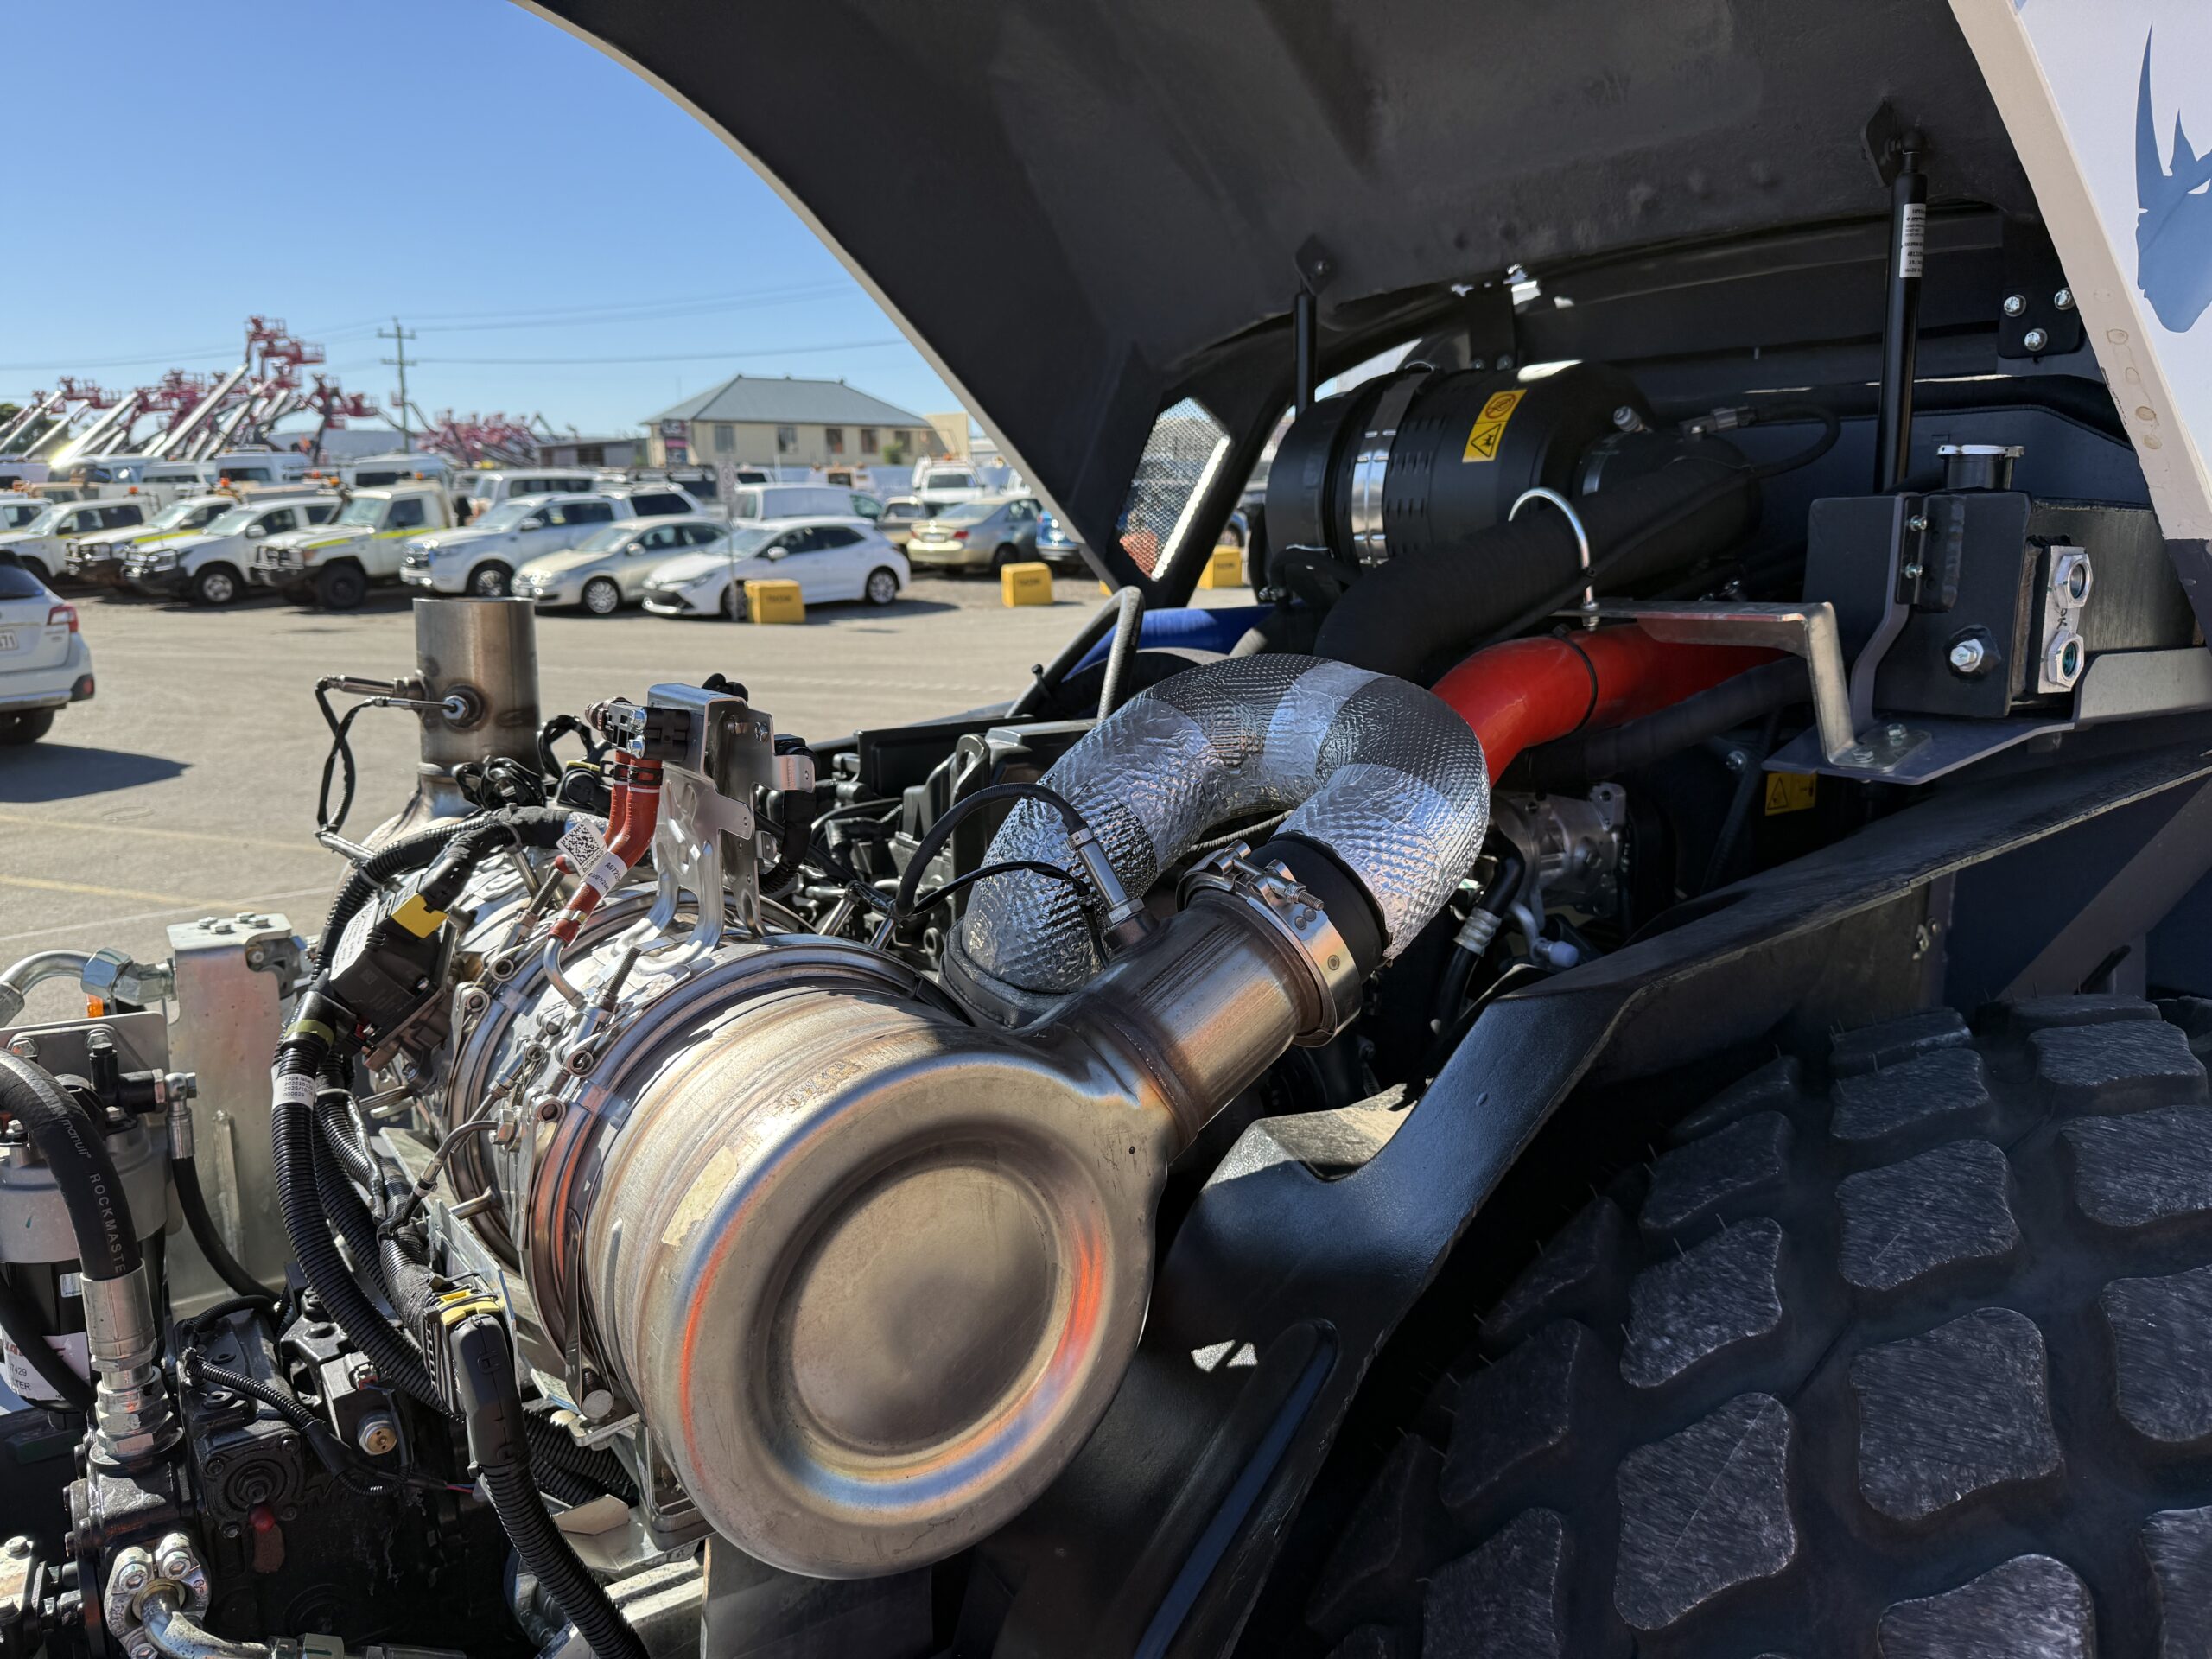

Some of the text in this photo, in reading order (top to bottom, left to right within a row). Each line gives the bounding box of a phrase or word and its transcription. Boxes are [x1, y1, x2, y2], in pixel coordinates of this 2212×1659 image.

[61, 1118, 89, 1156] manuli
[89, 1173, 126, 1274] ROCKMASTE
[14, 1378, 31, 1391] TER
